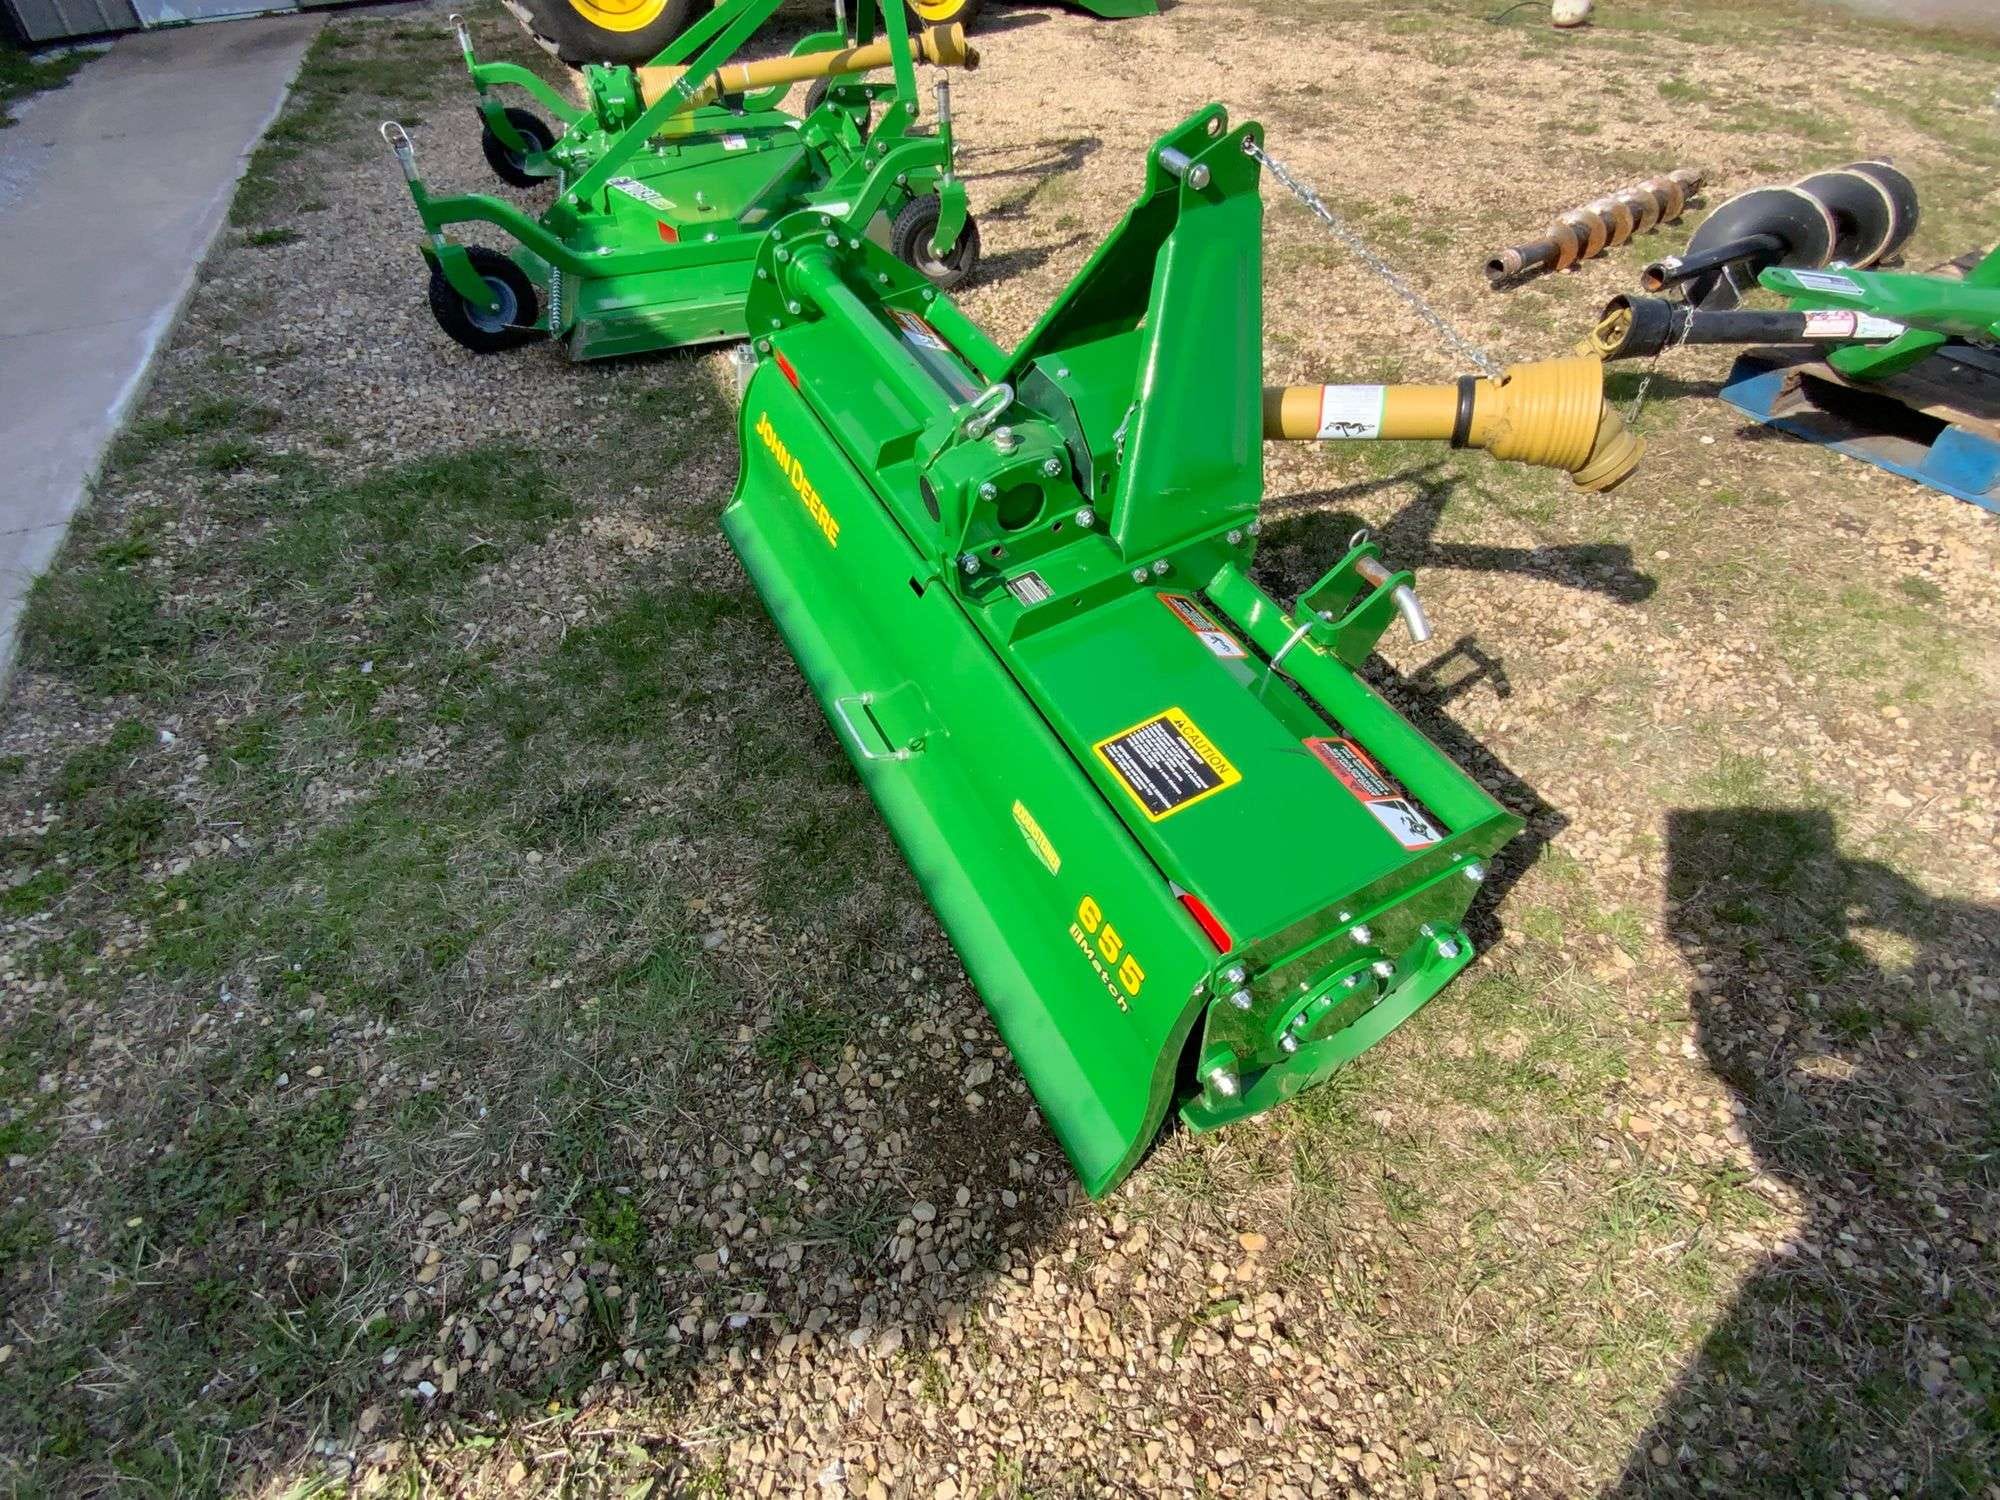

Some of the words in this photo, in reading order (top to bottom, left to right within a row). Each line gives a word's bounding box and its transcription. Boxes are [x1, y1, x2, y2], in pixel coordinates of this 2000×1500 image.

[756, 411, 791, 475] JOHN
[791, 458, 840, 549] DEERE
[1182, 726, 1230, 774] CAUTION
[1079, 895, 1145, 996] 655
